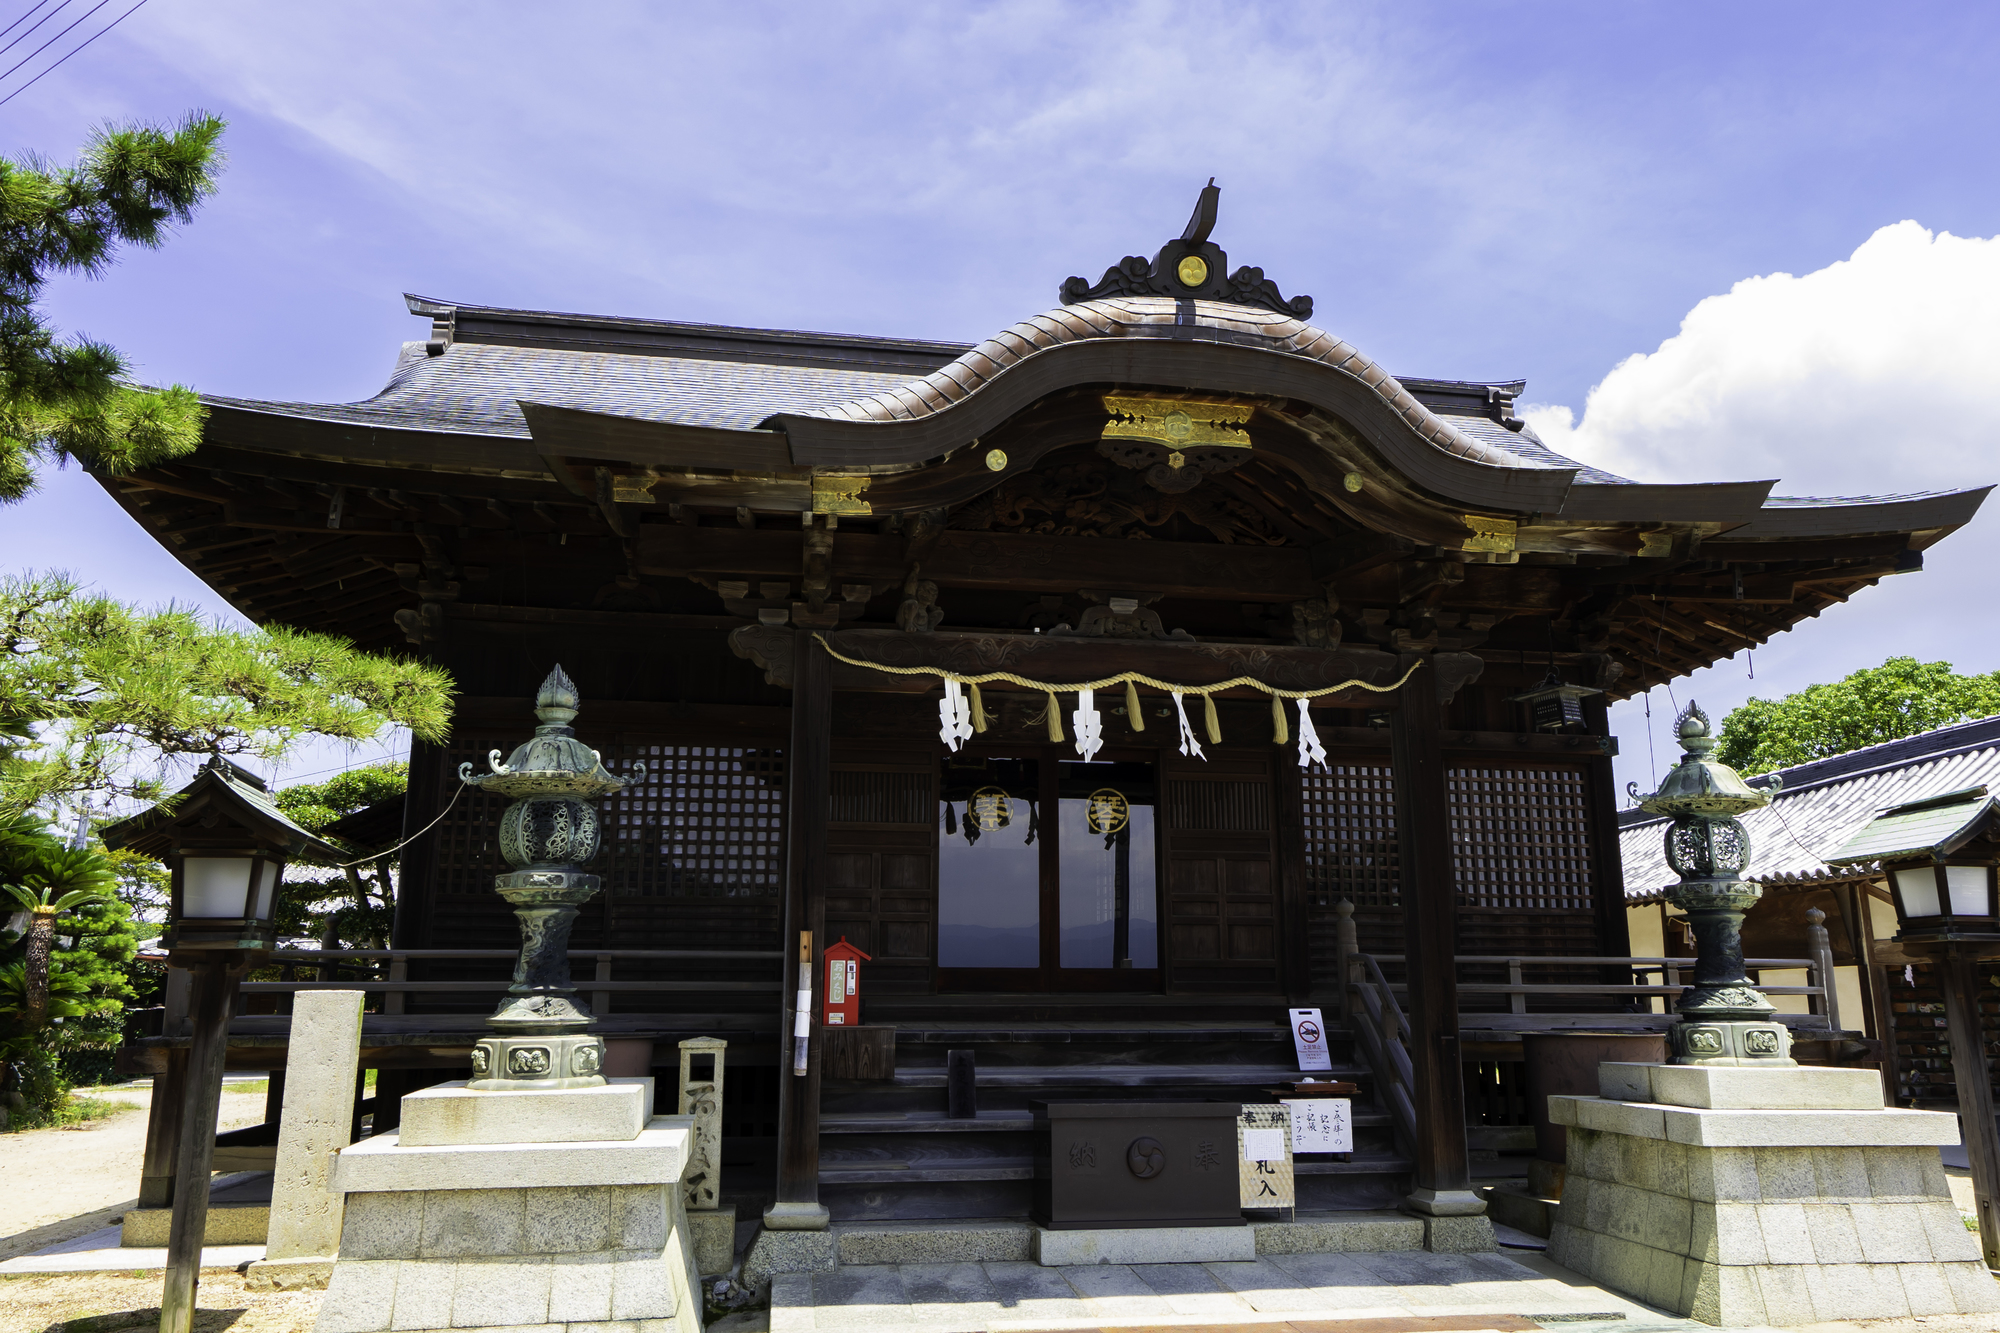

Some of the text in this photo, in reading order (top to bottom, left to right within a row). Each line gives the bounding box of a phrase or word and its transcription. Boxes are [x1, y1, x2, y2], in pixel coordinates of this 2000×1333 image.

[833, 962, 843, 1001] おみくじ
[1295, 1115, 1306, 1146] どうぞ
[1306, 1103, 1317, 1132] ご記帳
[1320, 1113, 1331, 1142] 記念に
[1333, 1103, 1345, 1146] ご参拝の
[1069, 1141, 1097, 1170] 納
[1194, 1140, 1221, 1171] 奉
